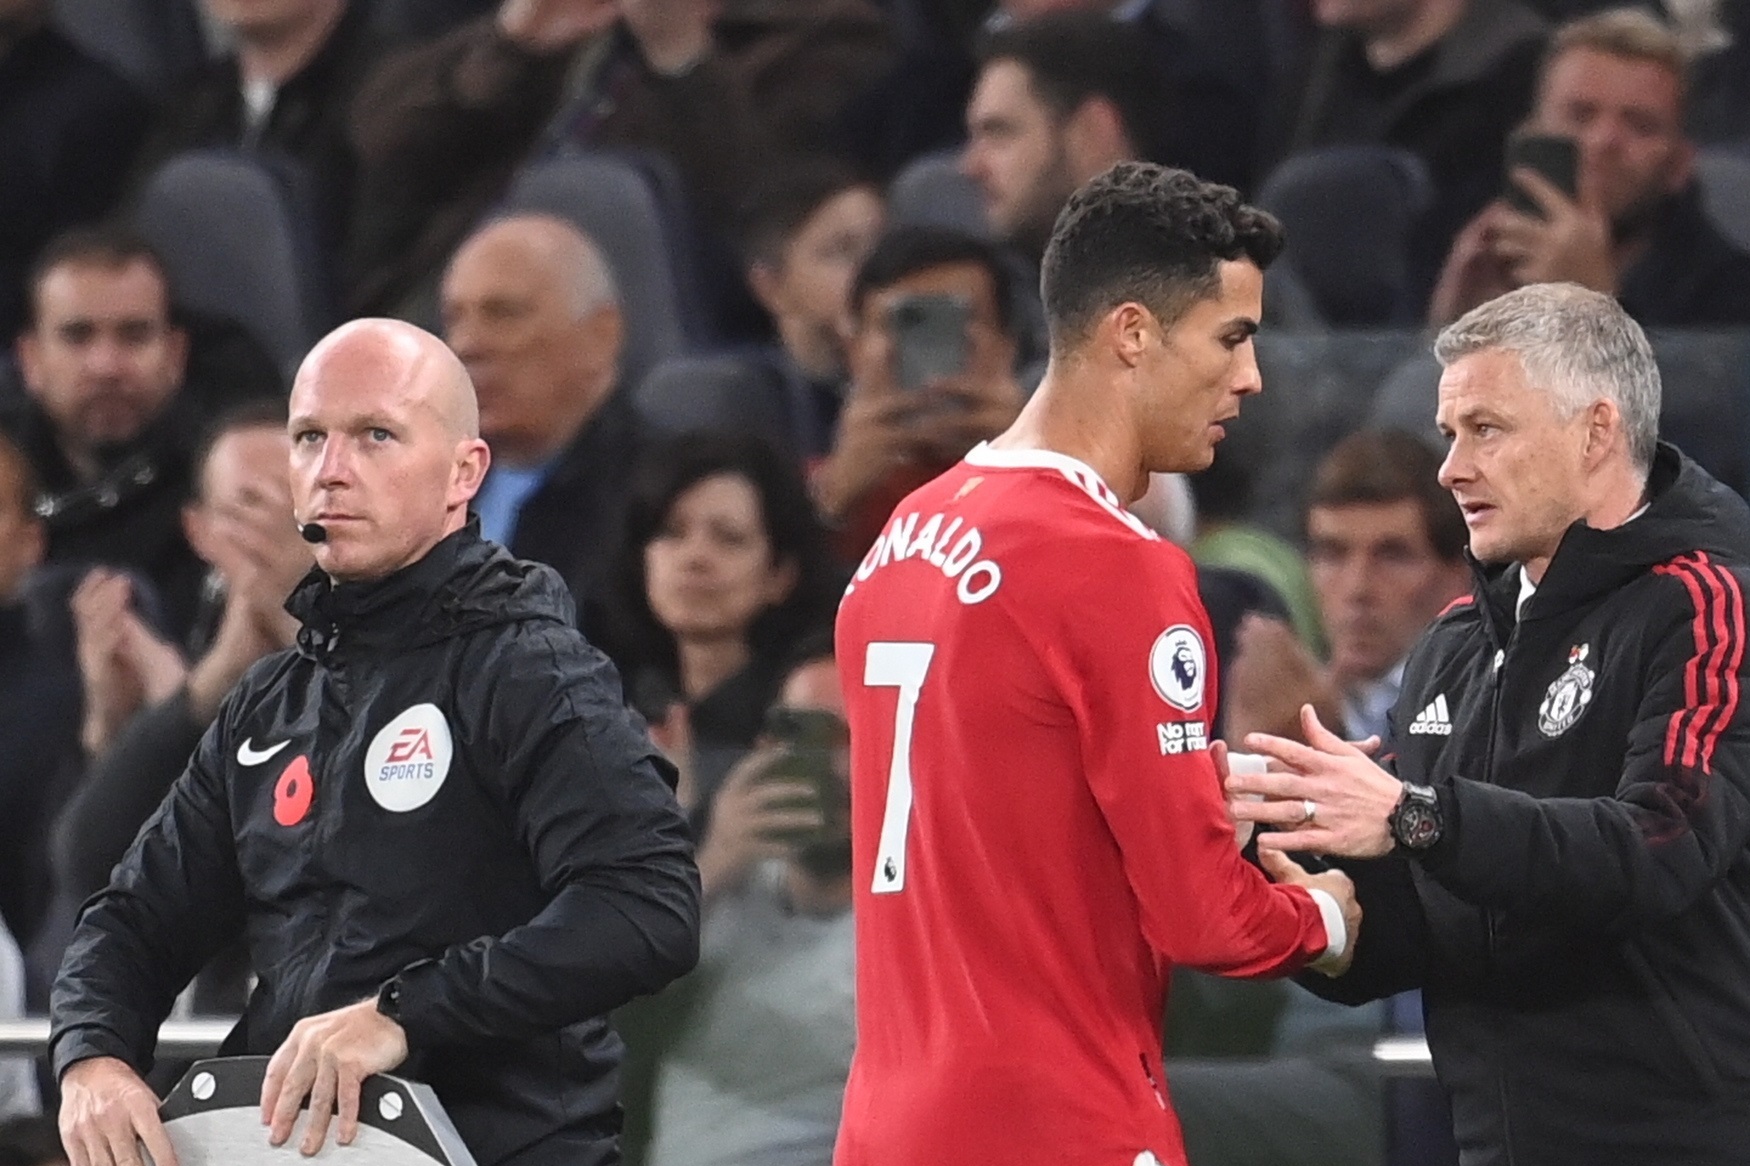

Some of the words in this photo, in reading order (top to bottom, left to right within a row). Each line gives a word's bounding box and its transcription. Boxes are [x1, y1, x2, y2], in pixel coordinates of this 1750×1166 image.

[845, 511, 1002, 604] ONALDO
[386, 728, 434, 762] EA
[1156, 722, 1184, 740] No
[379, 762, 434, 781] SPORTS
[864, 642, 935, 894] 7
